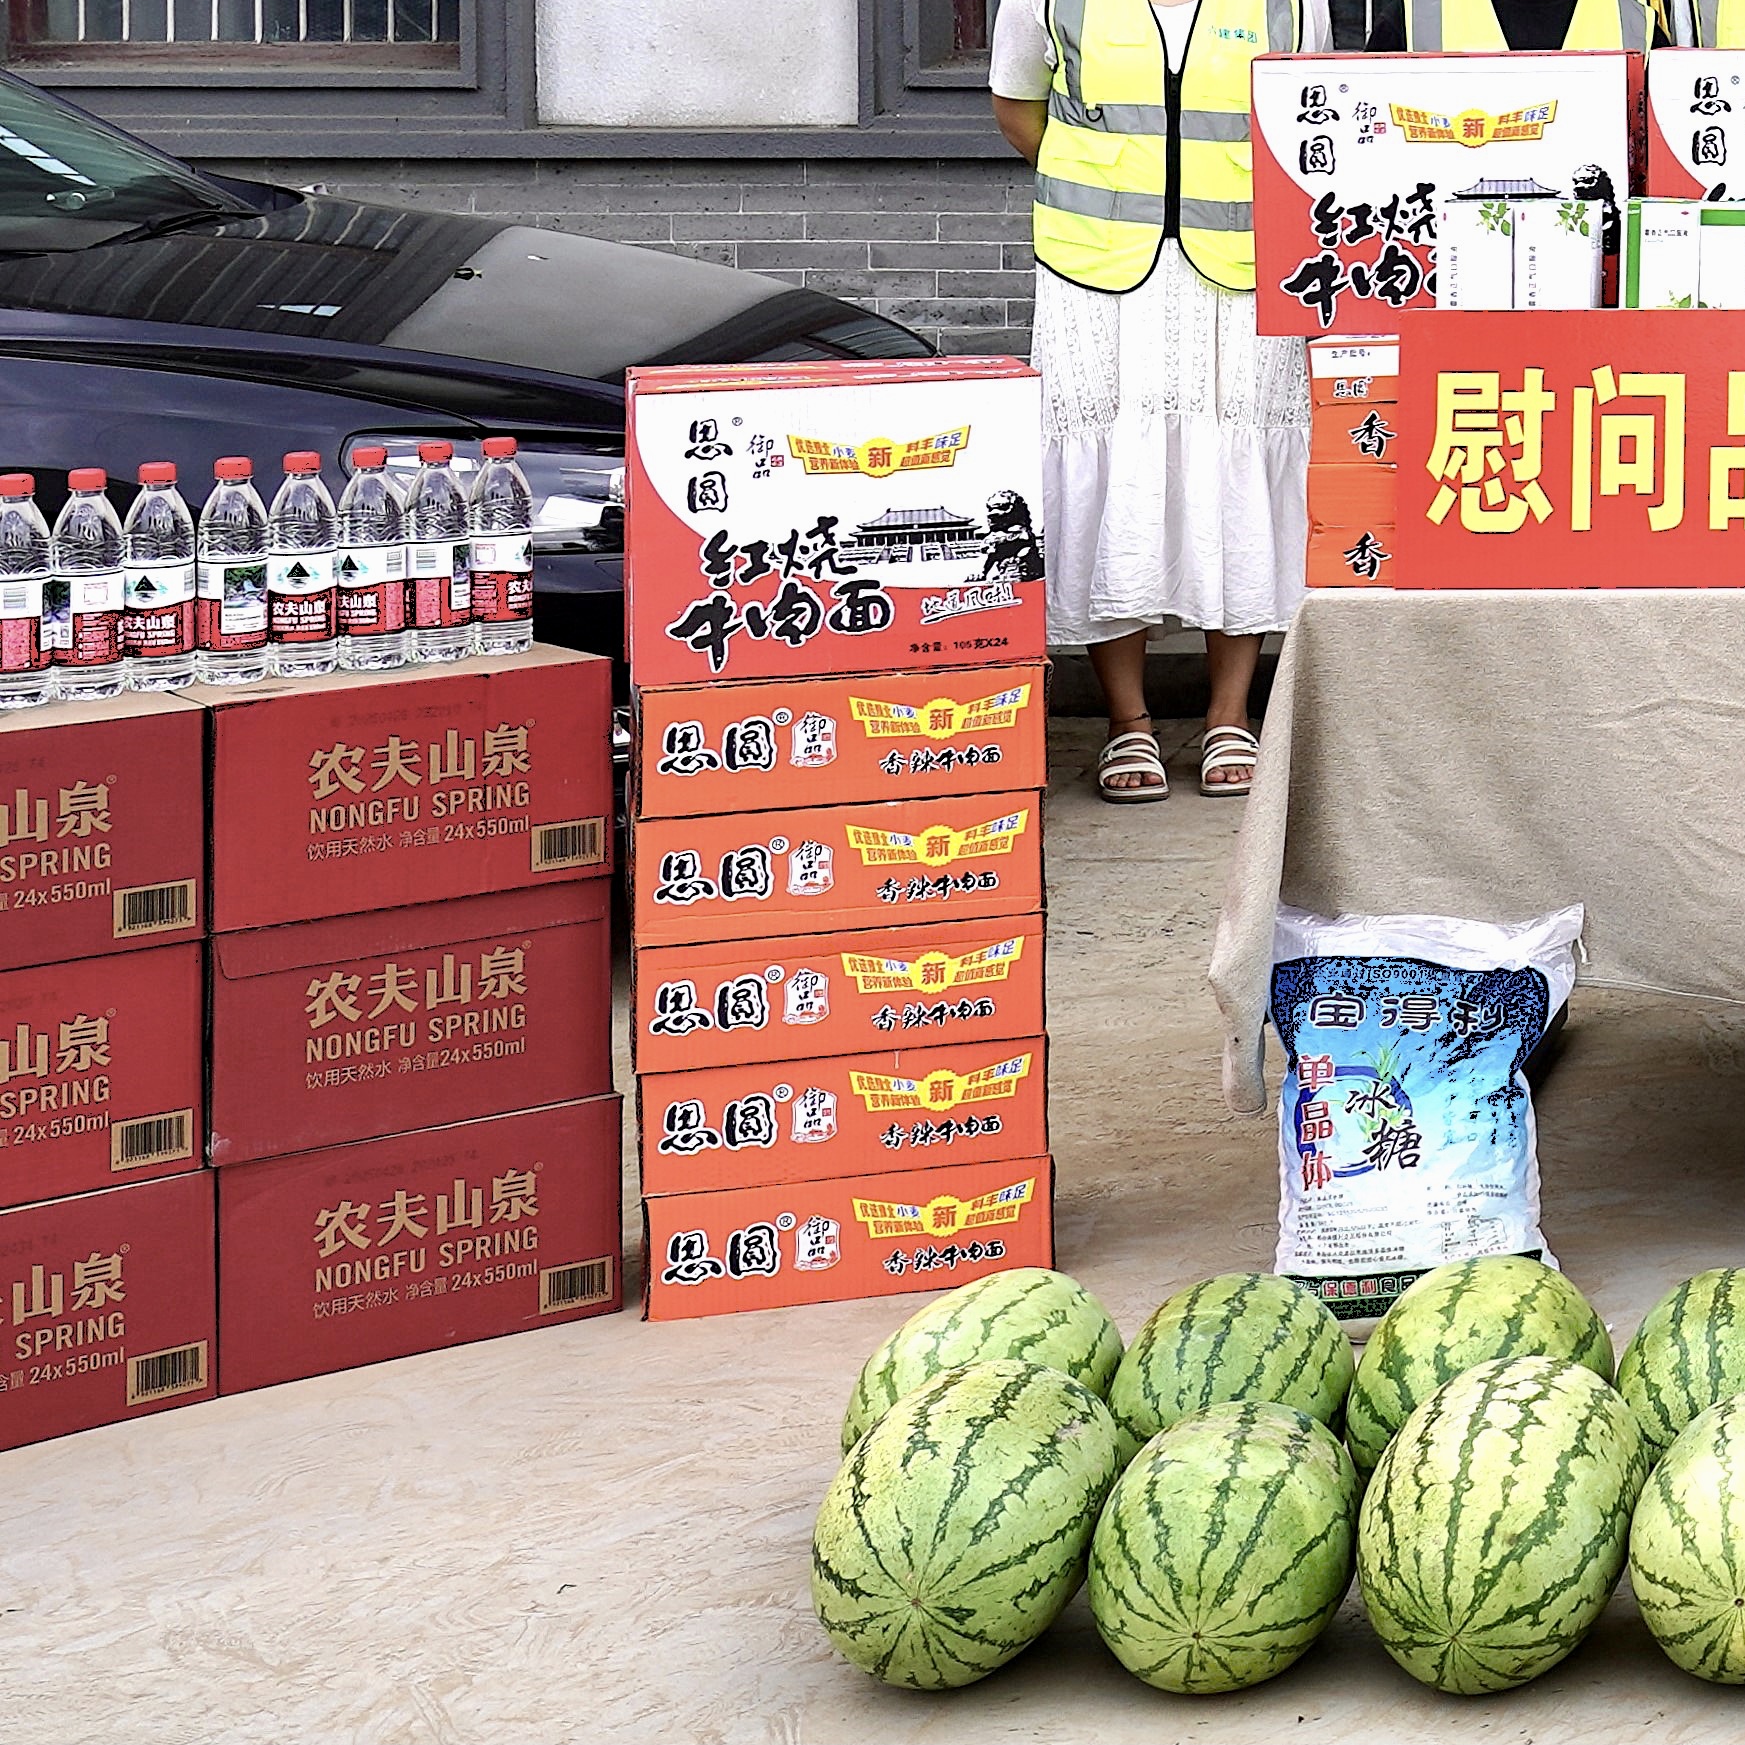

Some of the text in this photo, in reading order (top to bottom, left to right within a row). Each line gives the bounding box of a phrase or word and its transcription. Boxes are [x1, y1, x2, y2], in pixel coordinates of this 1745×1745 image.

[1348, 411, 1398, 460] 香
[868, 447, 892, 467] 新
[701, 515, 859, 588] 红烧
[1343, 532, 1393, 581] 香
[667, 580, 895, 672] 牛肉面
[930, 709, 952, 730] 新
[306, 722, 532, 801] 农夫山泉
[879, 745, 1002, 776] 香辣牛肉面
[310, 781, 530, 835] NONGFU SPRING
[0, 842, 111, 884] SPRING
[306, 835, 394, 862] 饮用天然水
[925, 836, 950, 855] 新
[876, 872, 999, 903] 香辣牛肉面
[304, 945, 528, 1030] 农夫山泉
[921, 962, 944, 982] 新
[305, 1002, 528, 1062] NONGFU SPRING
[871, 998, 995, 1031] 香辣牛肉面
[305, 1060, 392, 1088] 饮用天然水
[930, 1081, 952, 1102] 新
[879, 1115, 1002, 1149] 香辣牛肉面
[1297, 1053, 1336, 1192] 单晶体
[1344, 1079, 1423, 1174] 冰糖
[312, 1168, 540, 1258] 农夫山泉
[933, 1206, 956, 1227] 新
[314, 1226, 539, 1292] NONGFU SPRING
[883, 1240, 1005, 1275] 香辣牛肉面
[312, 1288, 400, 1320] 饮用天然水
[16, 1311, 125, 1361] SPRING
